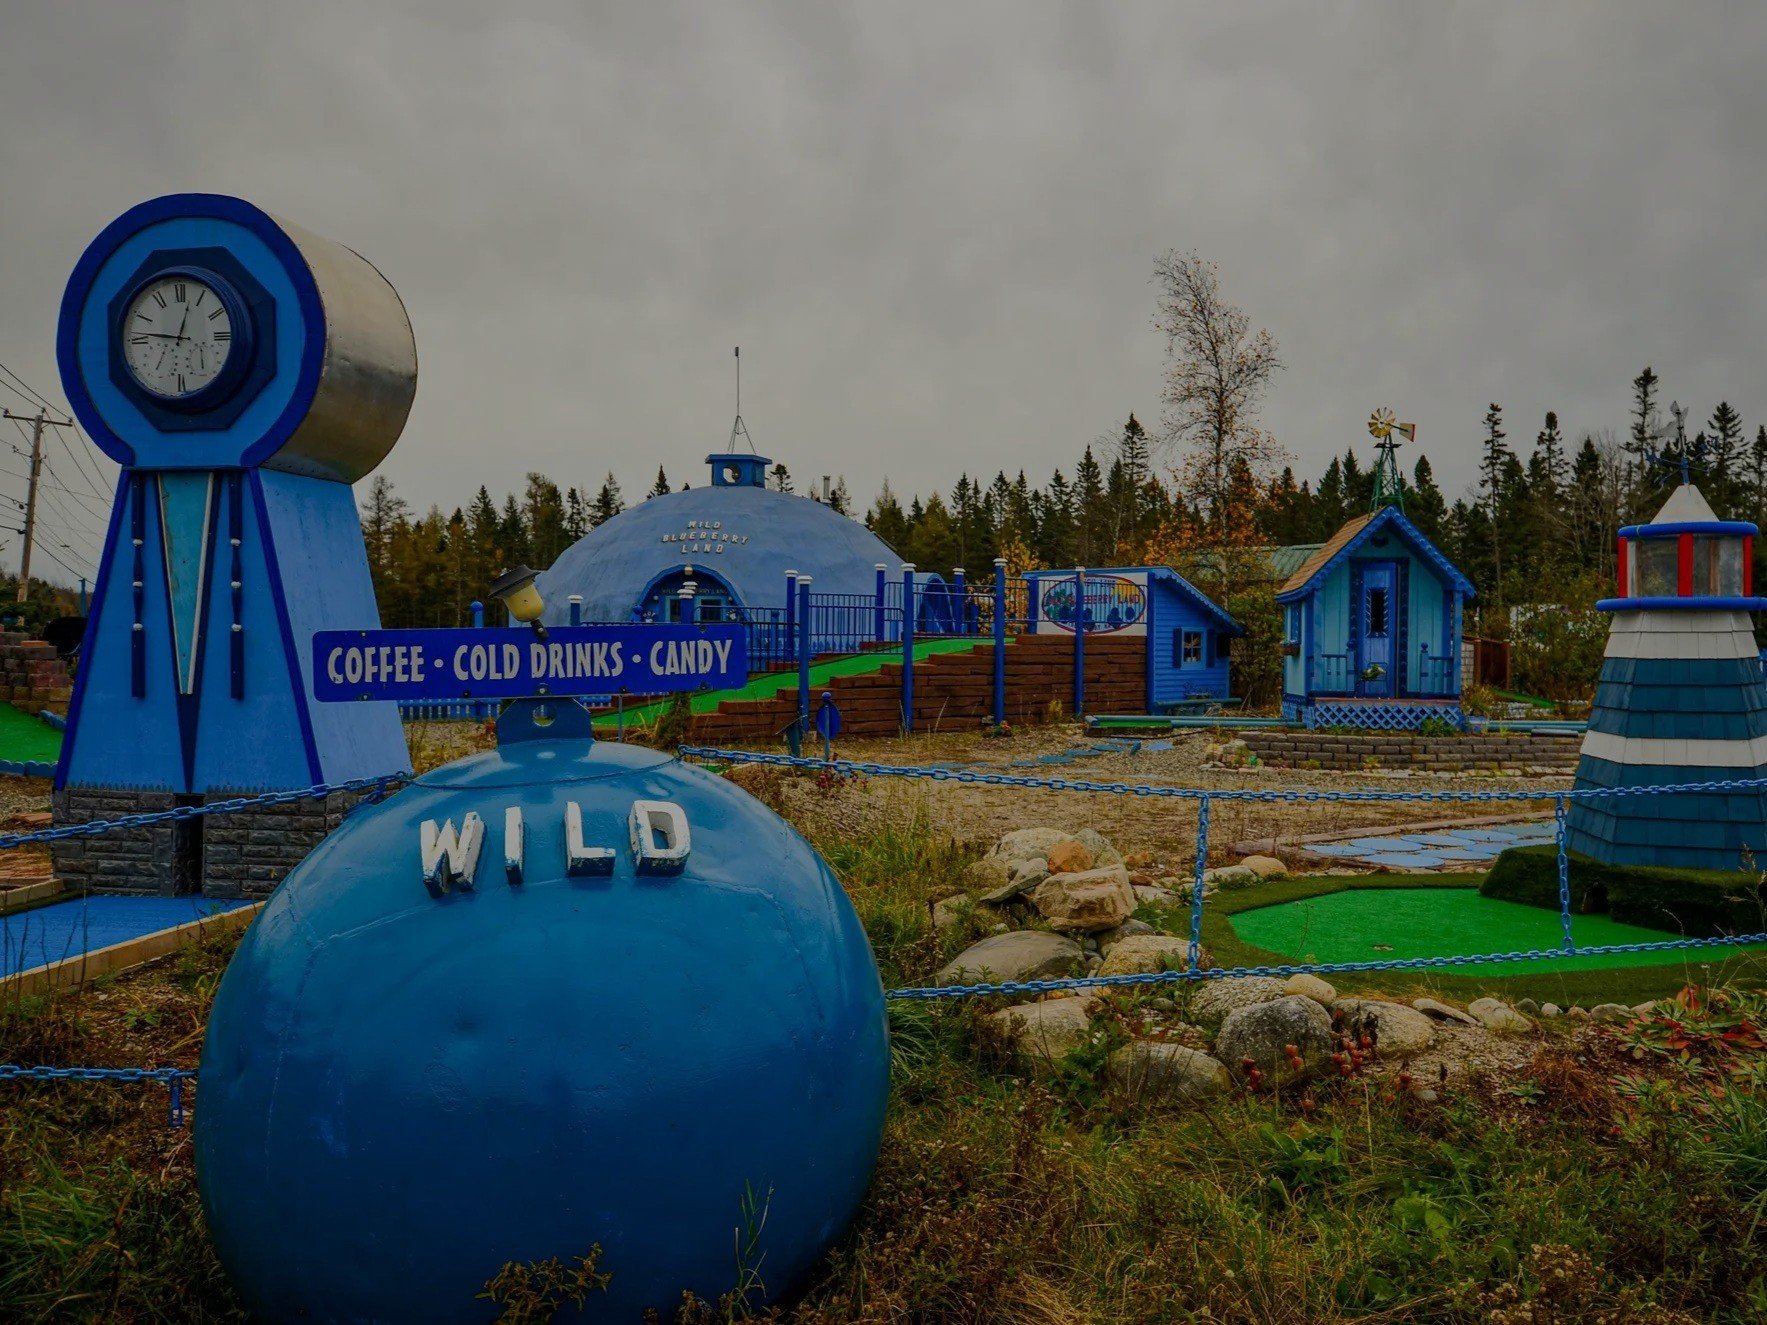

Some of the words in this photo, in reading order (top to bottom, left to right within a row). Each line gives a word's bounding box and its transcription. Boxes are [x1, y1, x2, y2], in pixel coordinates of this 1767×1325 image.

[687, 520, 720, 529] WILD
[662, 531, 748, 544] BLUEBERRY
[681, 543, 724, 554] LAND
[327, 645, 426, 684] COFFEE
[453, 643, 521, 681] COLD
[530, 641, 625, 679] DRINKS
[649, 639, 733, 677] CANDY
[420, 799, 692, 899] WILD
